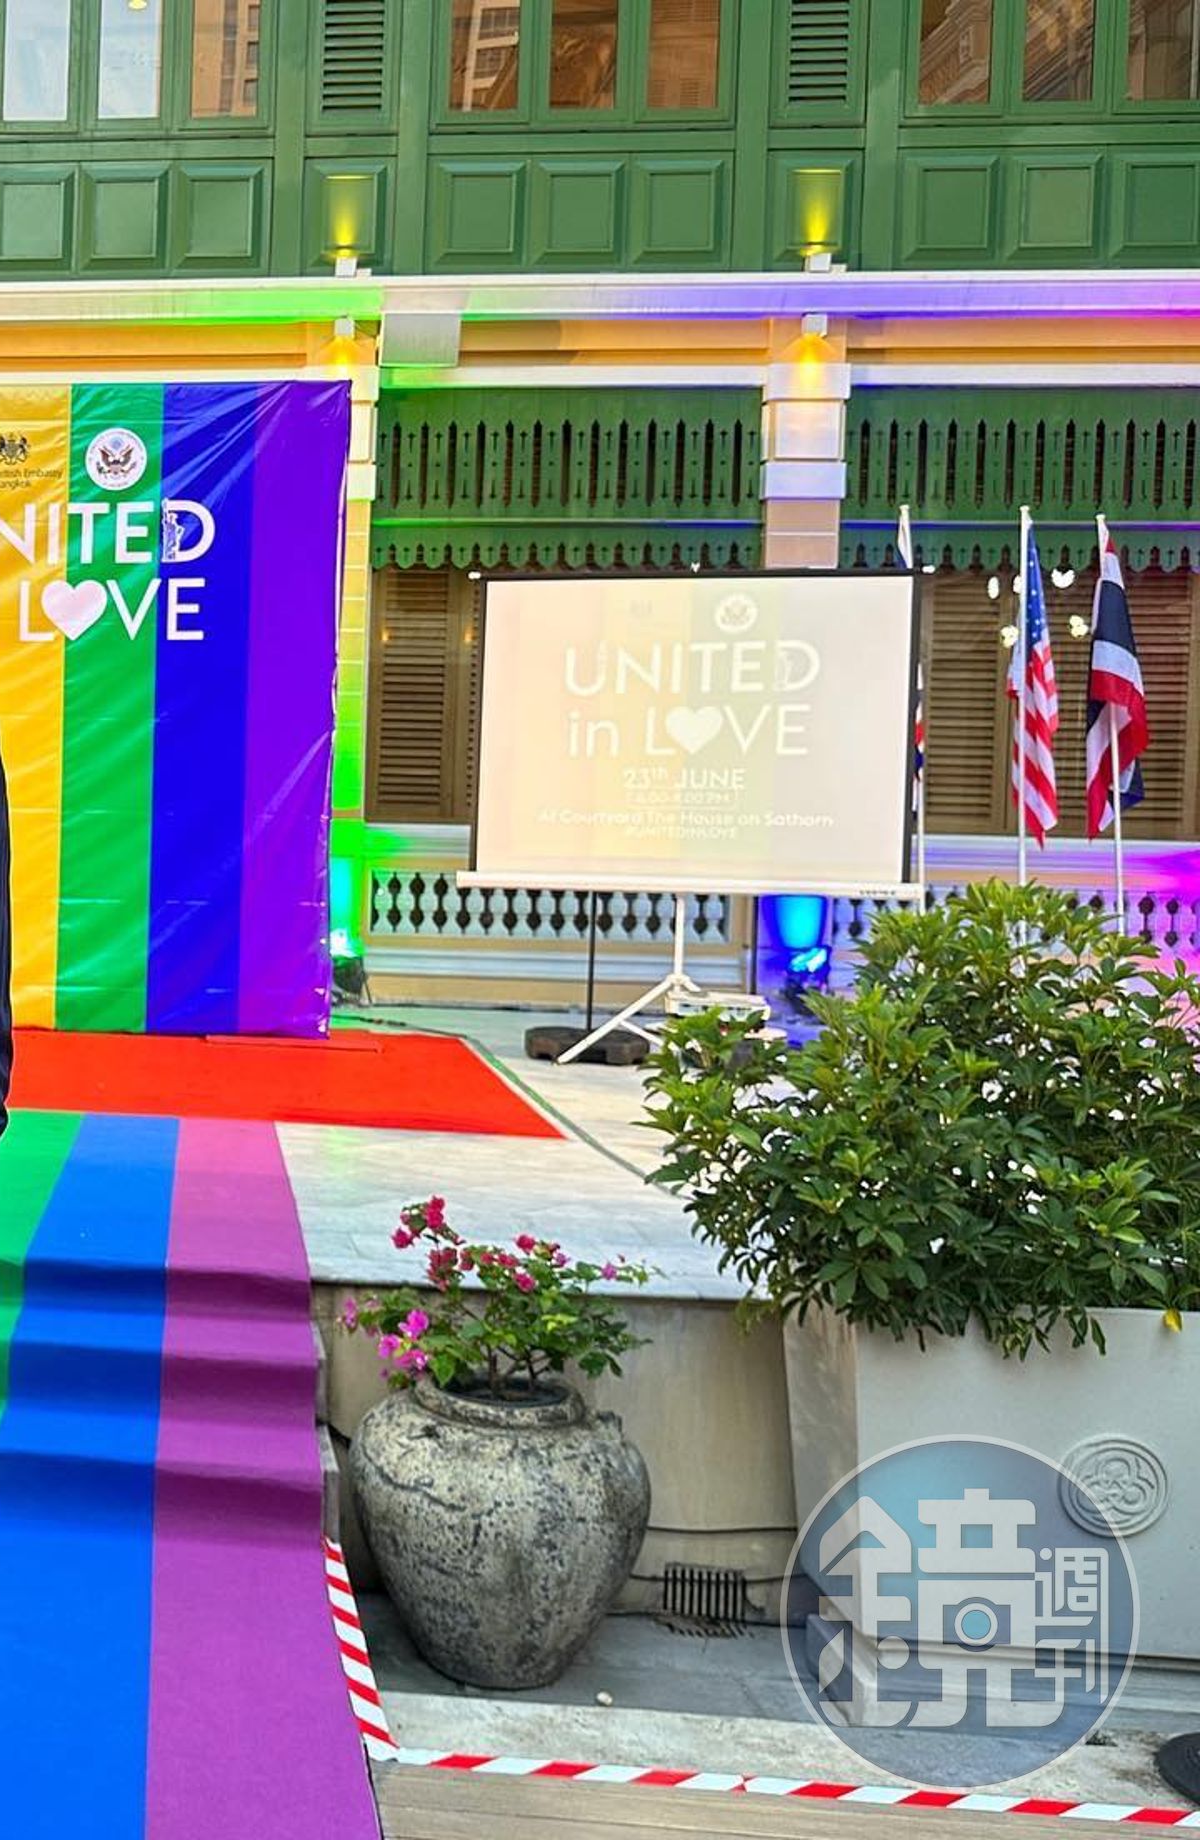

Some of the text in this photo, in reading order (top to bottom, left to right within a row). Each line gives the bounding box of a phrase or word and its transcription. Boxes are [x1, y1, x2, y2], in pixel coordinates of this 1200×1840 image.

[23, 468, 63, 481] Embassy
[564, 639, 820, 696] UNITED
[568, 711, 619, 757] in
[675, 768, 746, 789] JUNE
[680, 810, 734, 825] House
[738, 814, 760, 825] on
[764, 810, 834, 826] Sathorn
